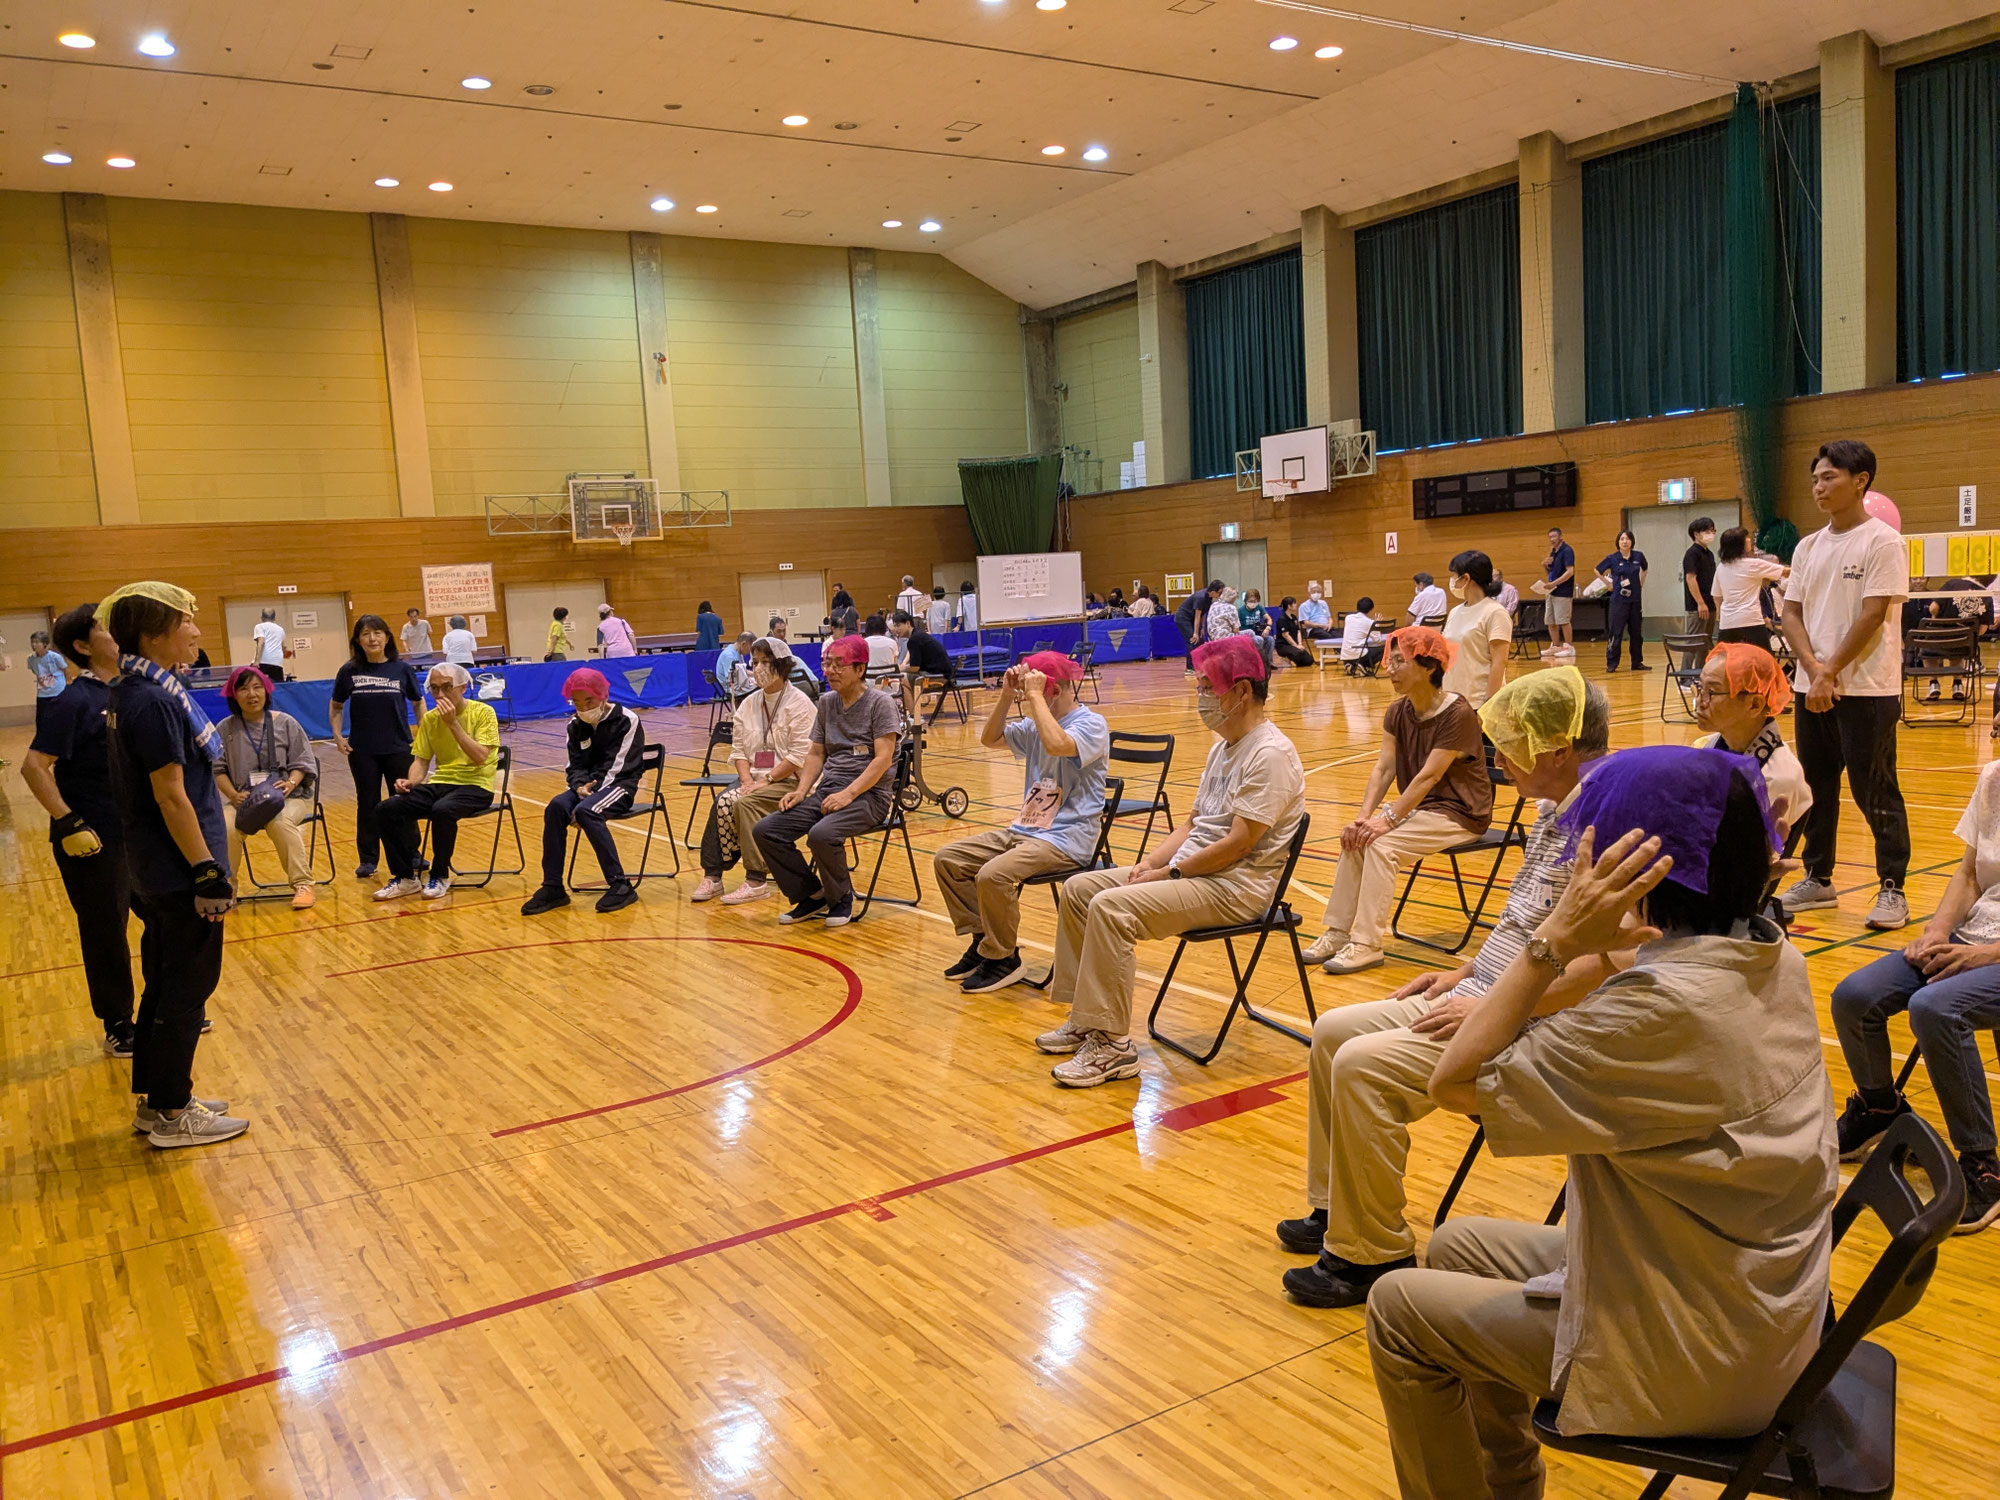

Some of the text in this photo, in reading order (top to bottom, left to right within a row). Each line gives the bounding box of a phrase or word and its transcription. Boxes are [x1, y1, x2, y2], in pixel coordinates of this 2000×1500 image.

[1963, 488, 1972, 524] 土足厳禁
[1387, 535, 1395, 551] A
